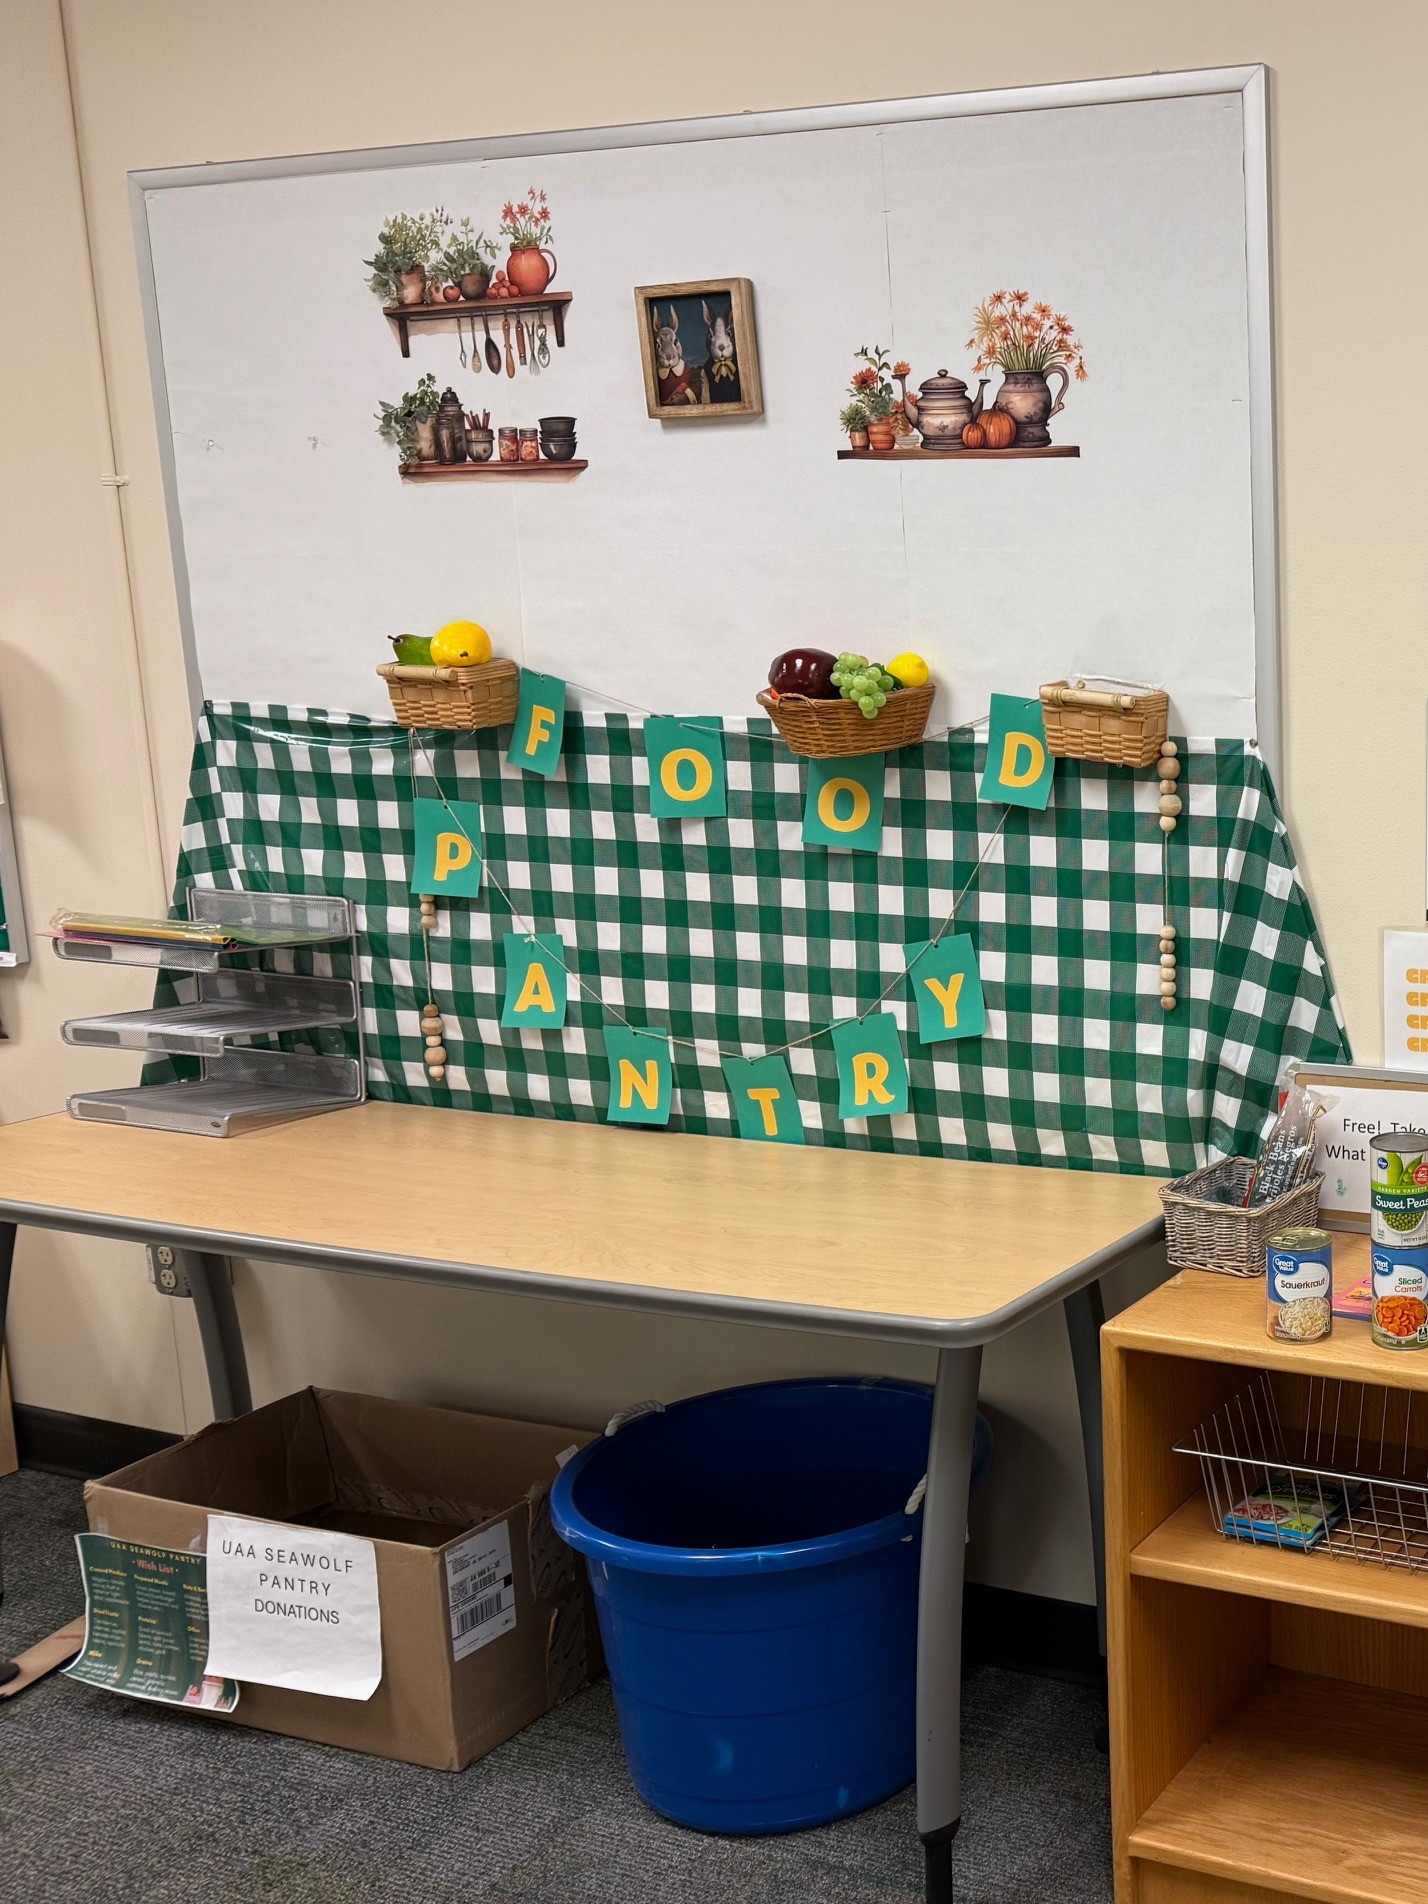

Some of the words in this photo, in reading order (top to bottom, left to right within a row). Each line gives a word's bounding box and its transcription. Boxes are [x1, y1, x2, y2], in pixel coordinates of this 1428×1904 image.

[1343, 1119, 1381, 1134] Free!
[1391, 1123, 1426, 1133] Take
[1326, 1145, 1366, 1161] What
[1259, 1163, 1275, 1195] Black
[1269, 1129, 1286, 1161] Beans
[1376, 1195, 1405, 1209] Sweet
[1275, 1258, 1294, 1267] Great
[1374, 1258, 1388, 1267] Great
[1281, 1278, 1325, 1289] Sauerkraut
[1398, 1277, 1422, 1285] Sliced
[110, 1541, 127, 1550] UAA
[130, 1545, 166, 1558] SEAWOLF
[170, 1553, 201, 1565] PANTRY
[222, 1540, 256, 1560] UAA
[265, 1548, 354, 1573] SEAWOLF
[136, 1560, 157, 1570] Wish
[159, 1563, 174, 1574] List
[259, 1573, 332, 1597] PANTRY
[254, 1598, 341, 1625] DONATIONS
